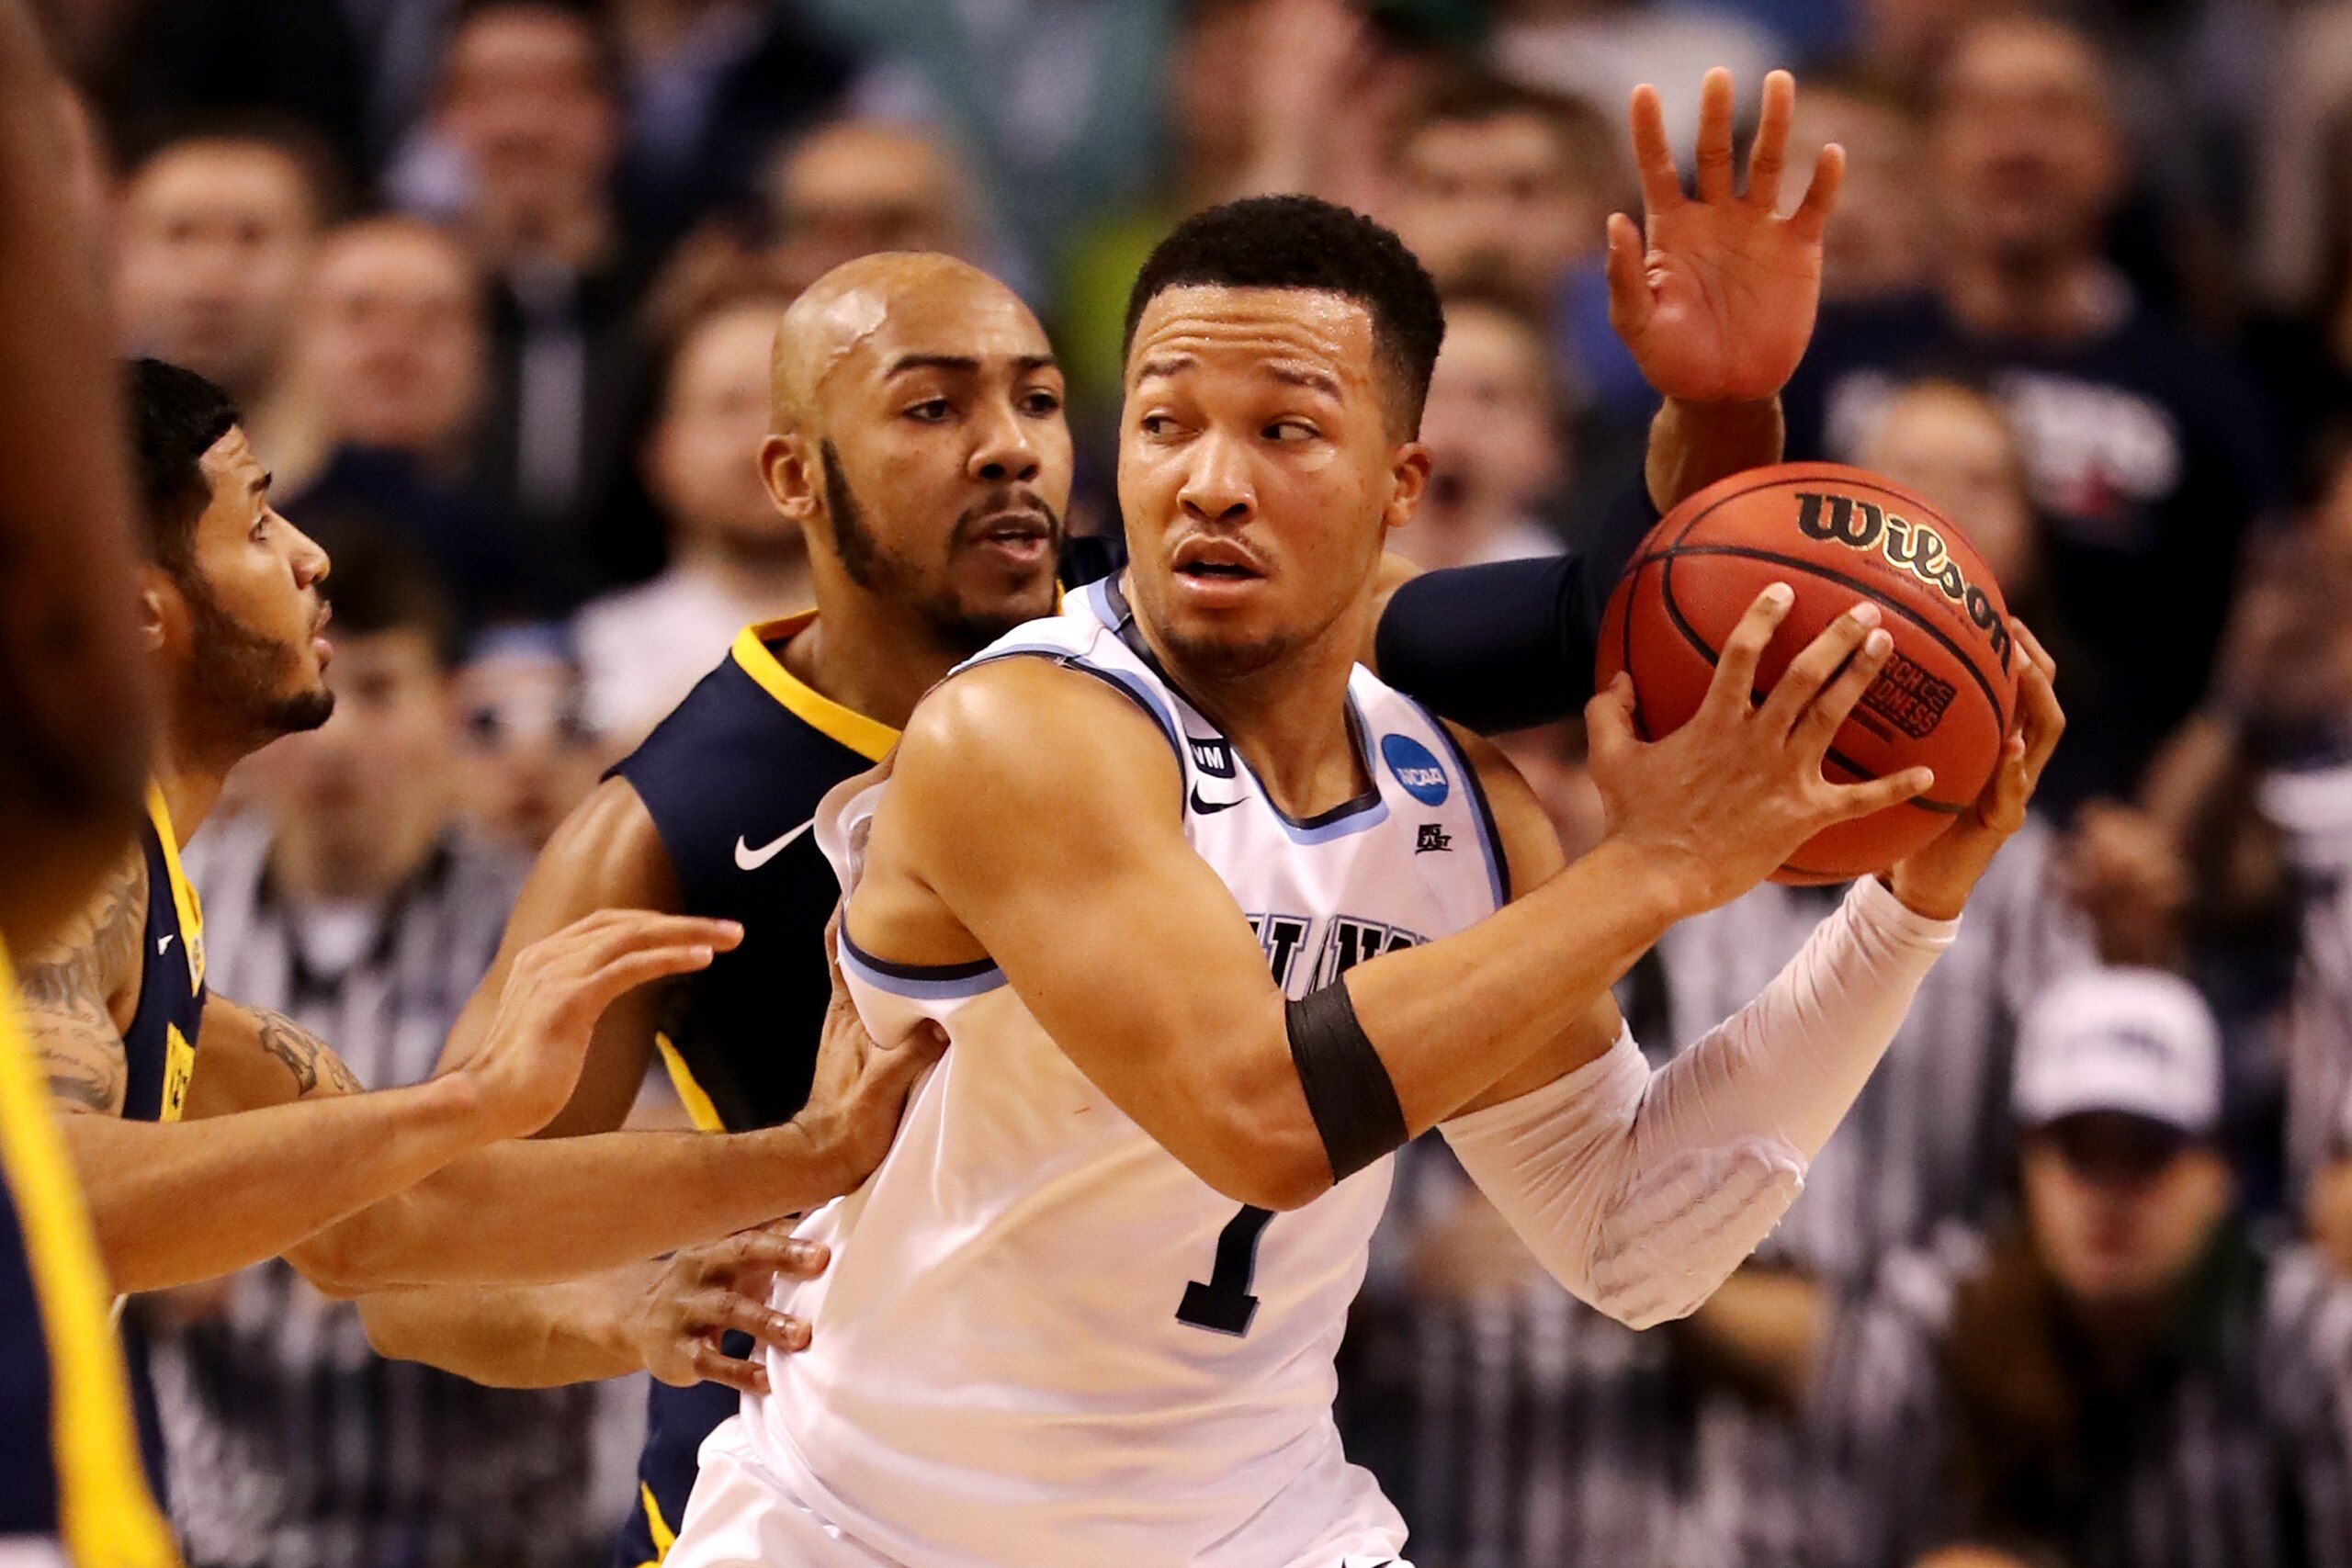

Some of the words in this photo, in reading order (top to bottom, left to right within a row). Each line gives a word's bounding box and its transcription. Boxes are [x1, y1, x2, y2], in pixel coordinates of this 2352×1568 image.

[1794, 492, 2010, 678] Wilson
[1881, 651, 1925, 692] RCH
[1869, 675, 1939, 734] DNESS
[1396, 767, 1447, 786] NCAA
[1175, 1203, 1278, 1337] 1
